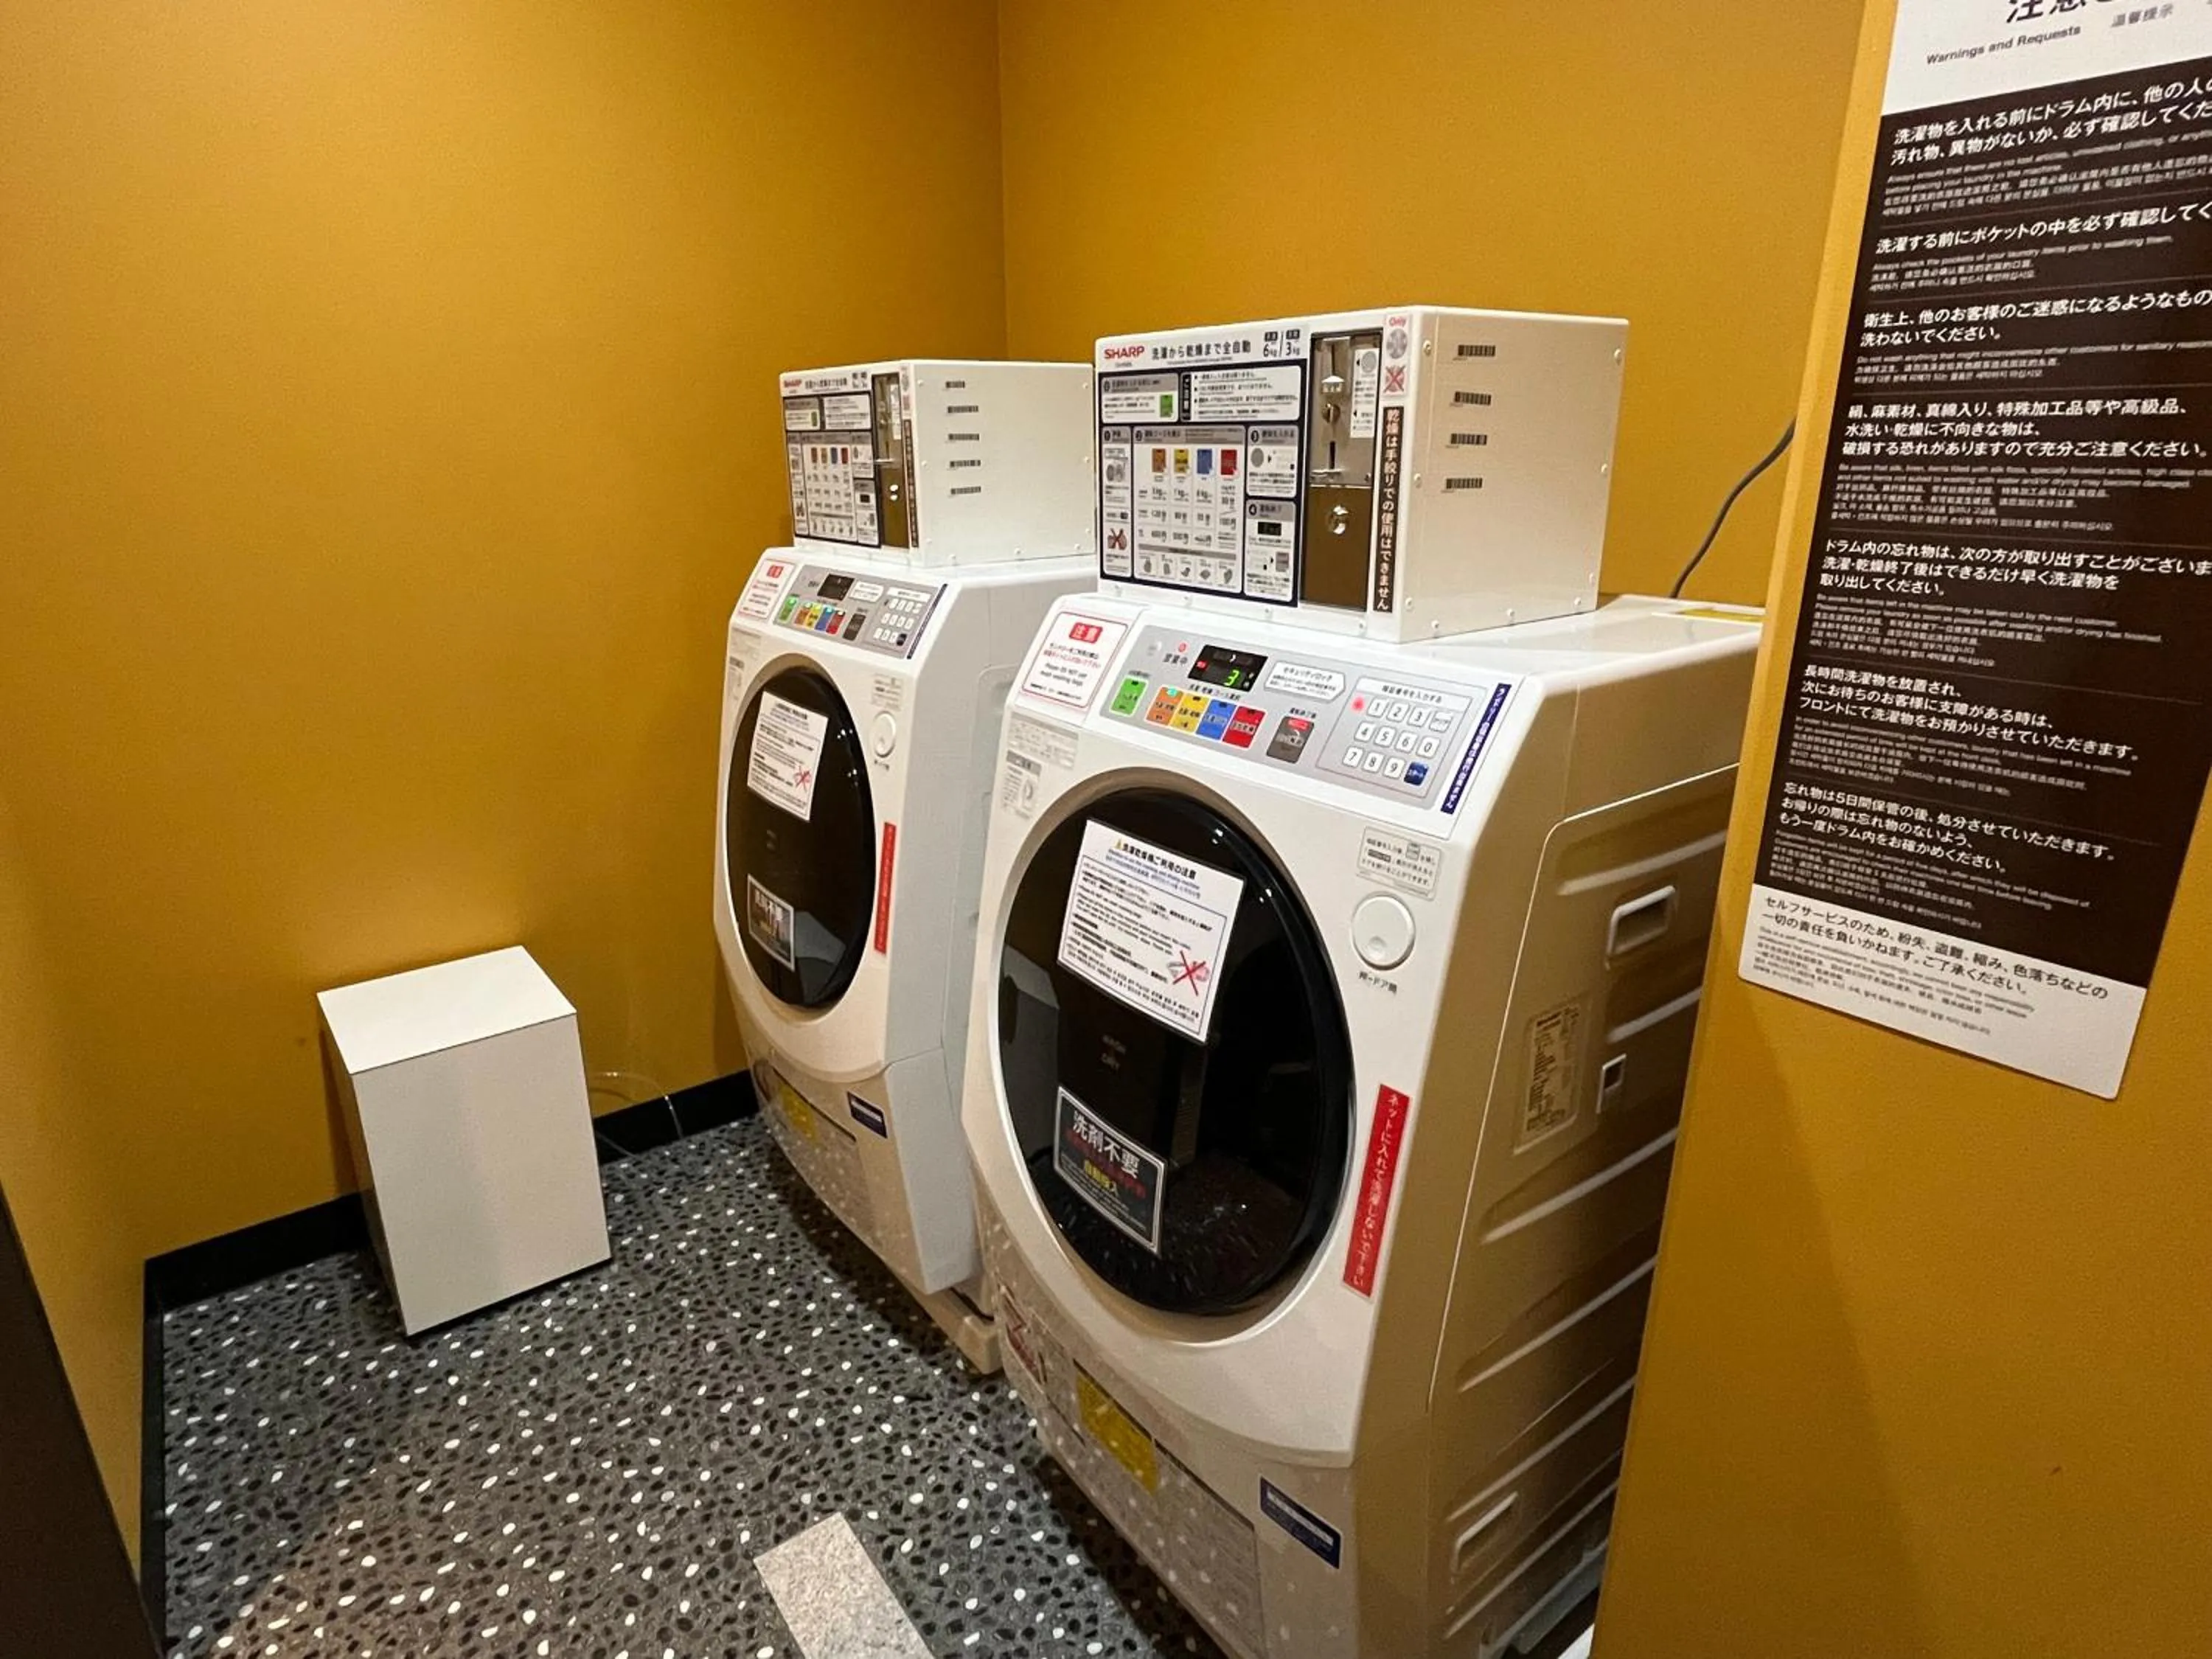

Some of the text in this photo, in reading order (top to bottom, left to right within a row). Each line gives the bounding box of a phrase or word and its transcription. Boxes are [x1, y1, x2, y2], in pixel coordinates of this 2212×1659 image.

[1927, 25, 2081, 65] Warnings and Requests
[1860, 327, 2001, 347] 洗わないでください。
[1104, 346, 1144, 359] SHARP
[1820, 573, 1944, 596] 取り出してください。
